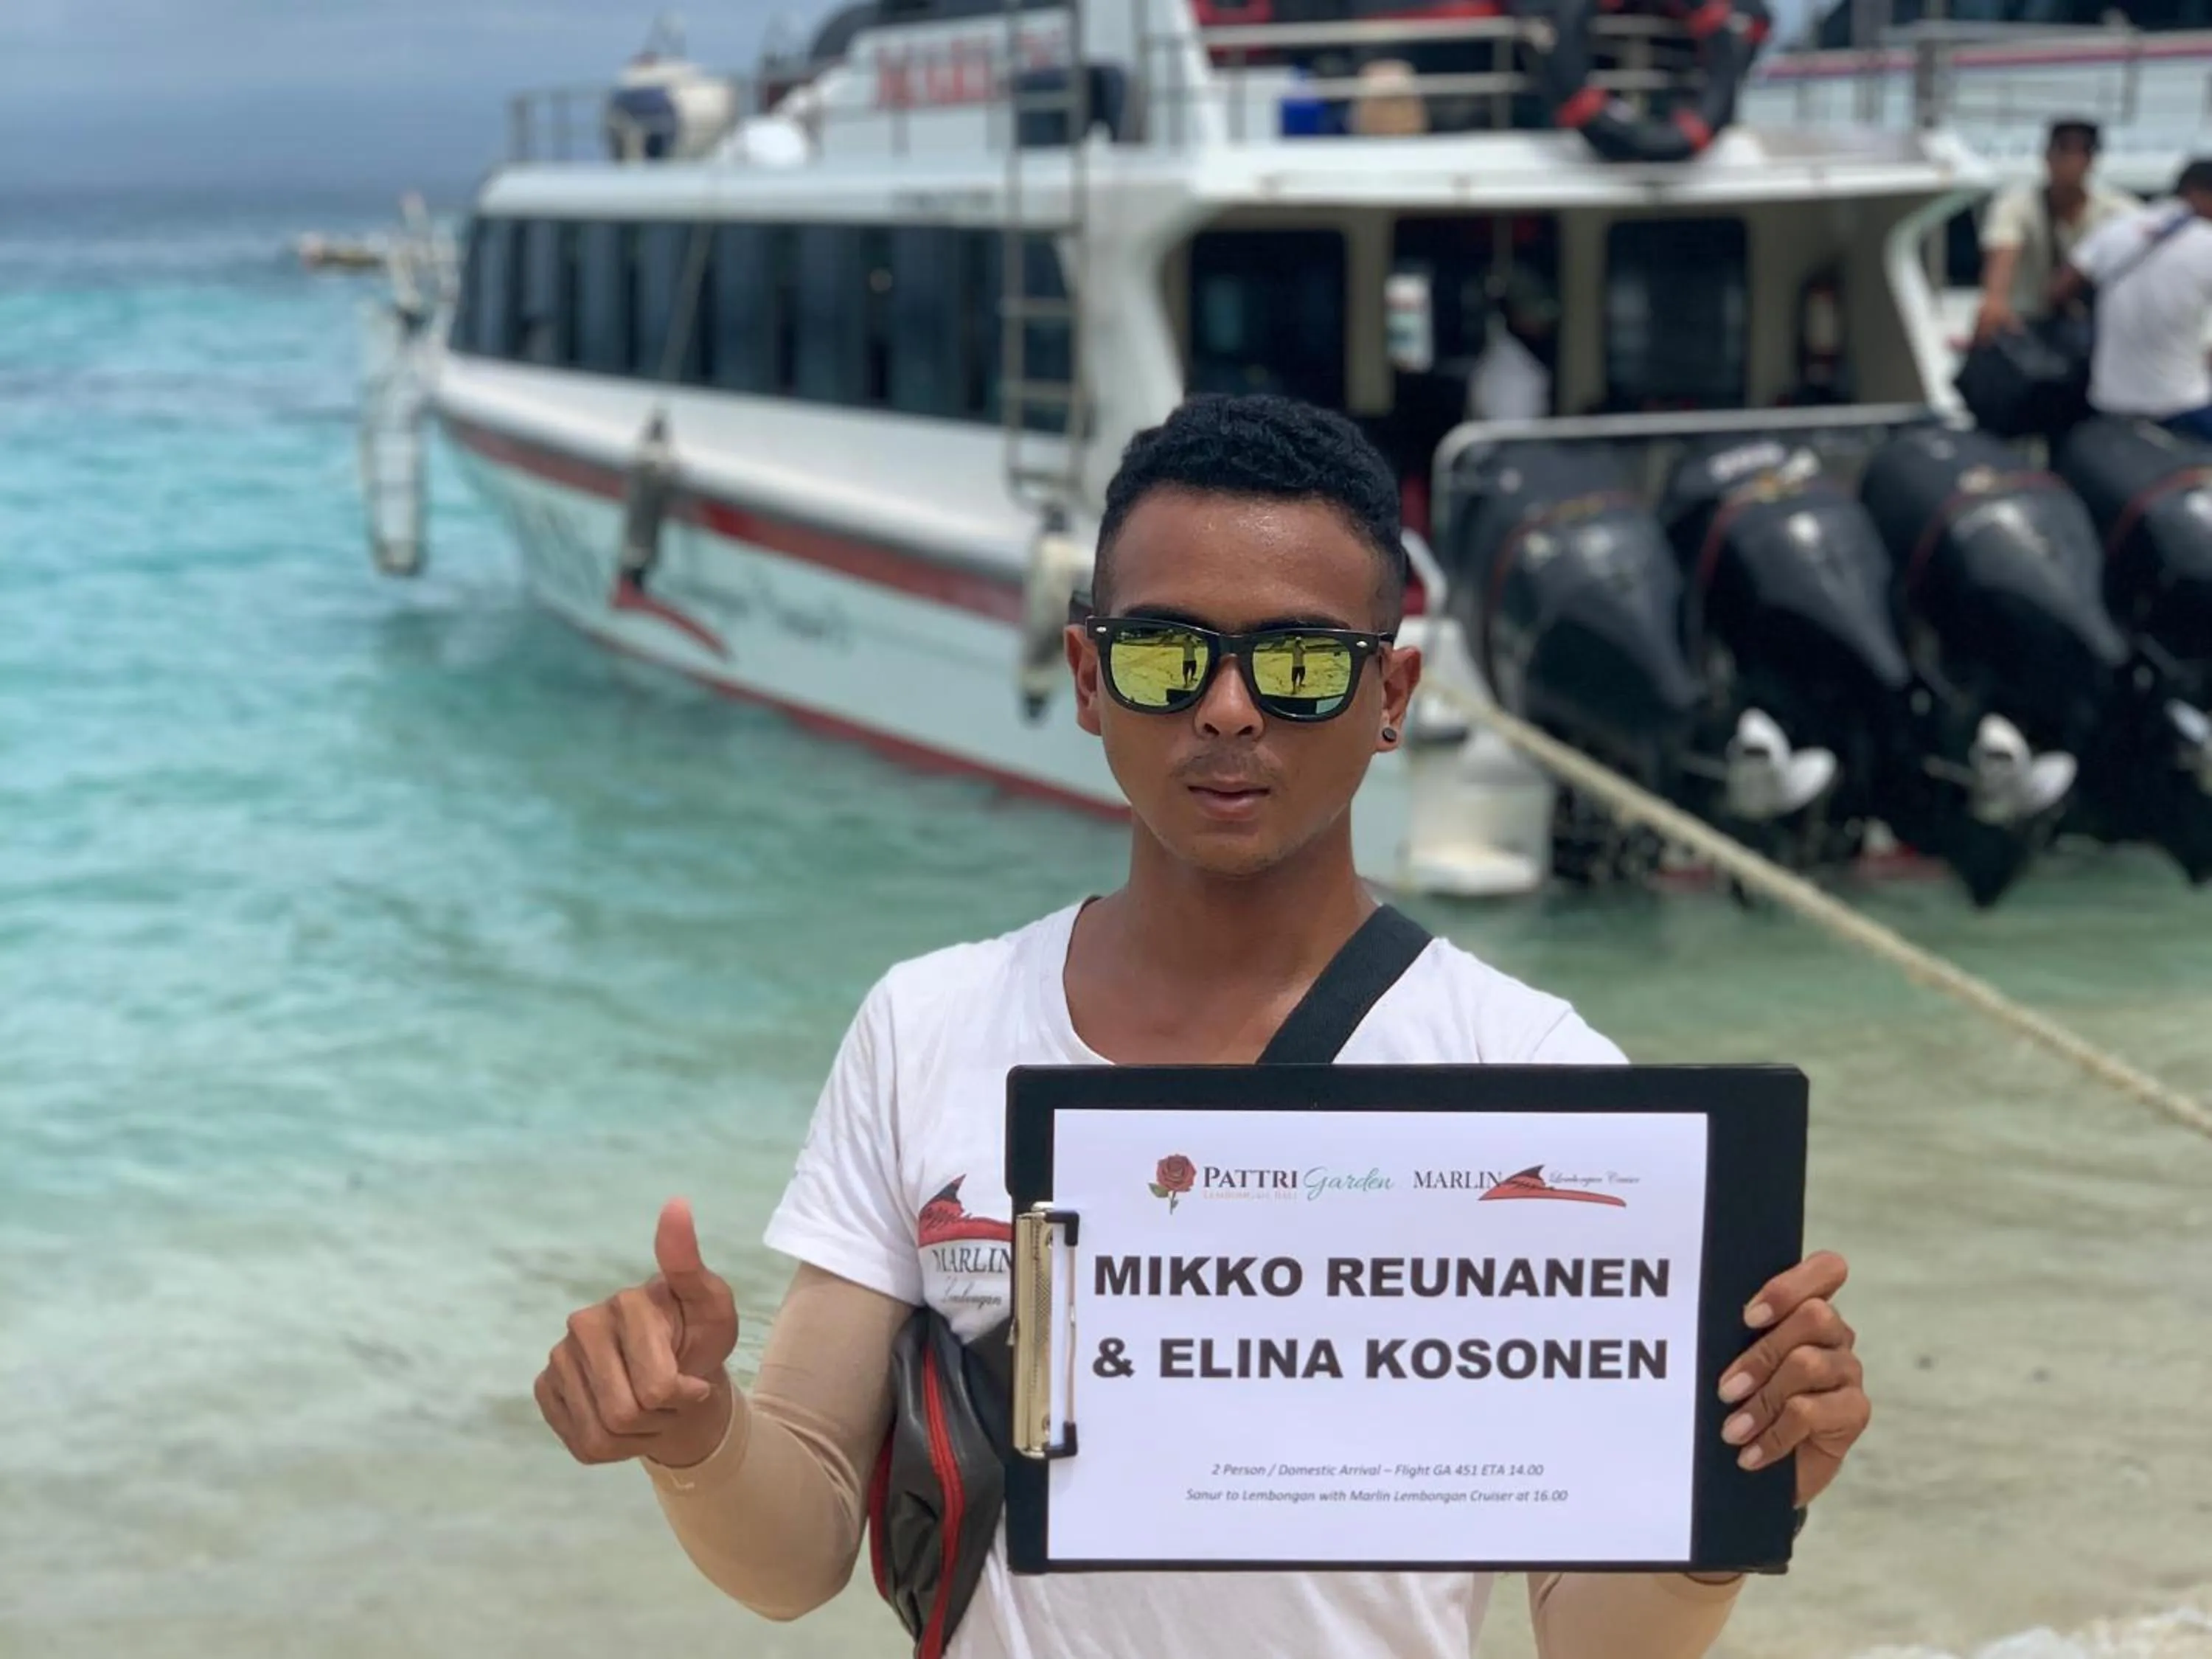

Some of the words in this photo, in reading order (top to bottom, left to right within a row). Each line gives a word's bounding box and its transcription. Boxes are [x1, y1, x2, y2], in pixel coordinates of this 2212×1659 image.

[1203, 1166, 1298, 1189] PATTRI
[1303, 1166, 1395, 1201] Garden
[1413, 1170, 1502, 1189] MARLIN
[1095, 1256, 1303, 1297] MIKKO
[1326, 1257, 1670, 1298] REUNANEN
[1092, 1338, 1135, 1378] &
[1160, 1338, 1343, 1379] ELINA
[1366, 1338, 1668, 1380] KOSONEN
[1211, 1464, 1220, 1475] 2
[1222, 1464, 1267, 1476] Person
[1278, 1464, 1336, 1476] Domestic
[1339, 1464, 1382, 1476] Arrival
[1394, 1464, 1430, 1479] Flight
[1433, 1464, 1452, 1476] GA
[1455, 1464, 1478, 1476] 451
[1481, 1464, 1506, 1476] ETA
[1509, 1464, 1545, 1476] 14.00
[1186, 1488, 1222, 1501] Sanur
[1225, 1489, 1239, 1501] to
[1242, 1489, 1315, 1503] Lembongan
[1319, 1490, 1347, 1502] with
[1349, 1489, 1391, 1502] Marlin
[1394, 1489, 1467, 1504] Lembongan
[1470, 1489, 1514, 1502] Cruiser
[1516, 1491, 1530, 1502] at
[1534, 1489, 1569, 1502] 16.00
